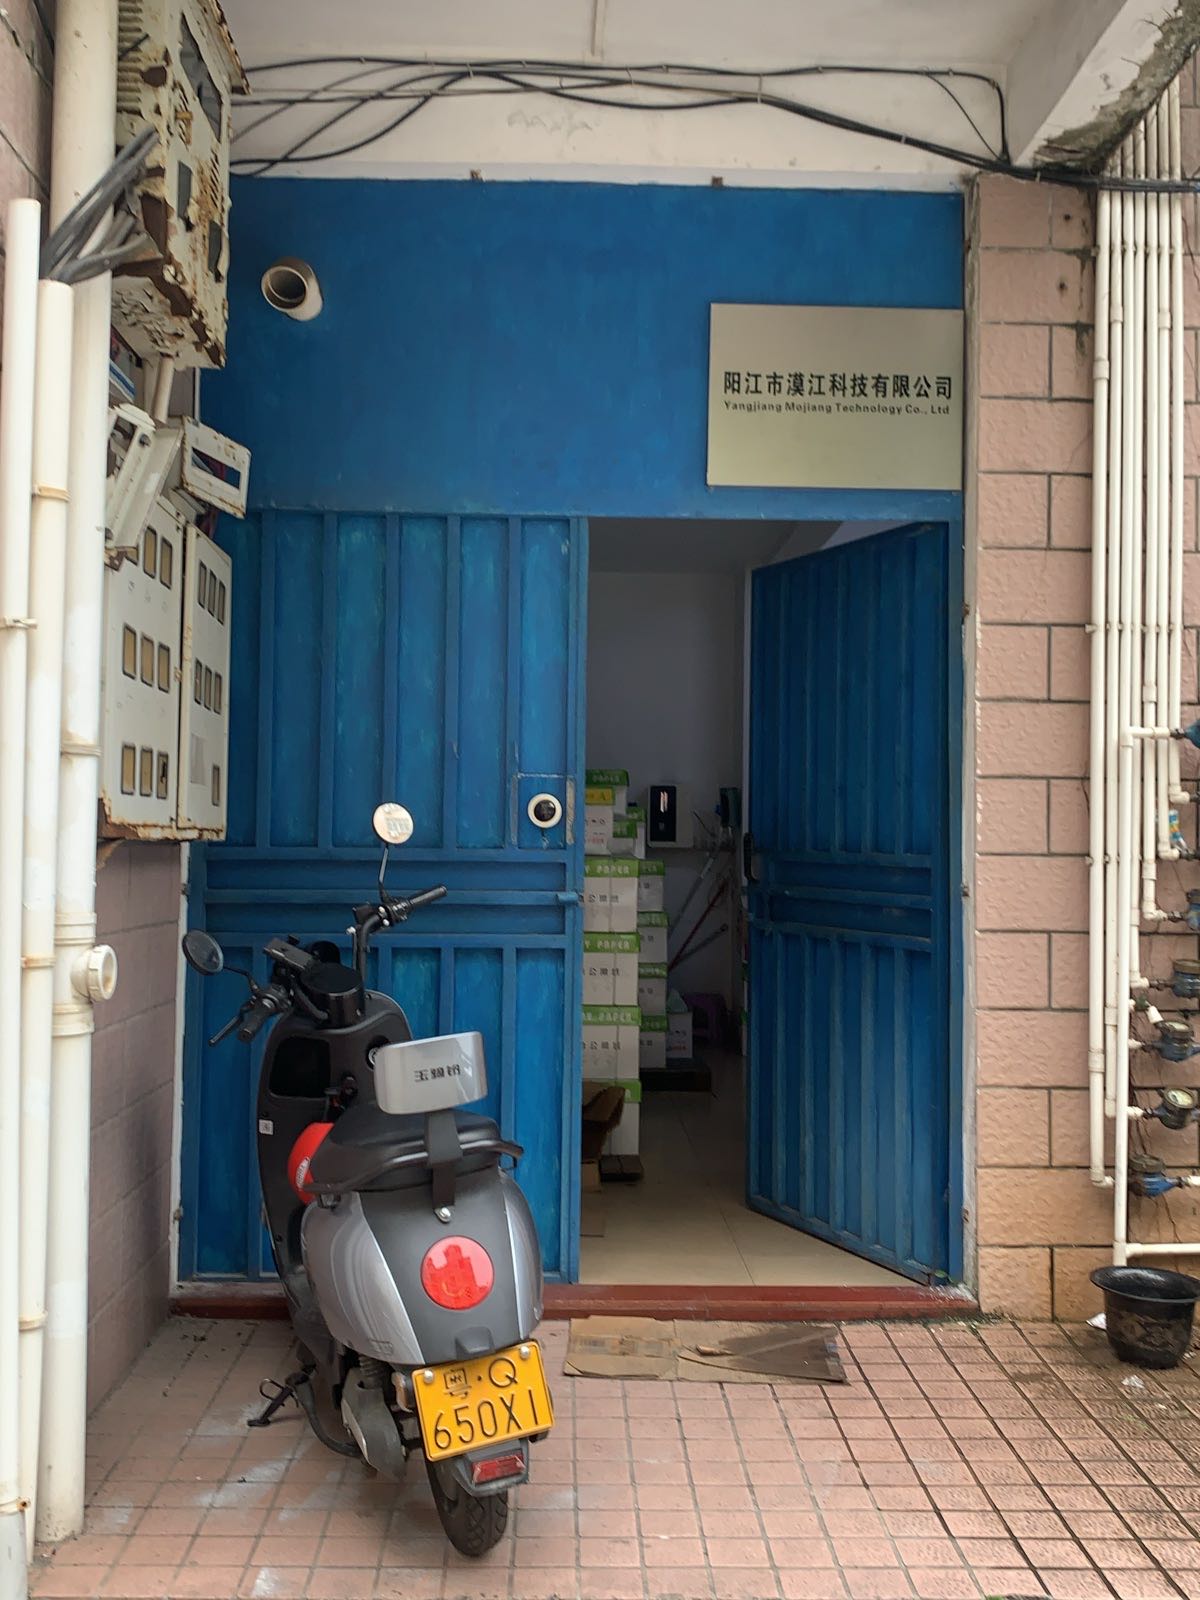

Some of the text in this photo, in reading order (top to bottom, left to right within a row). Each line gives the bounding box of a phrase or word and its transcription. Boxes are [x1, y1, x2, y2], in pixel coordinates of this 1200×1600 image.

[723, 371, 952, 400] 阳江市漠江科技有限公司
[724, 401, 782, 413] Yangjiang
[785, 402, 832, 414] Mojiang
[836, 403, 901, 415] Technology
[931, 405, 949, 415] Ltd
